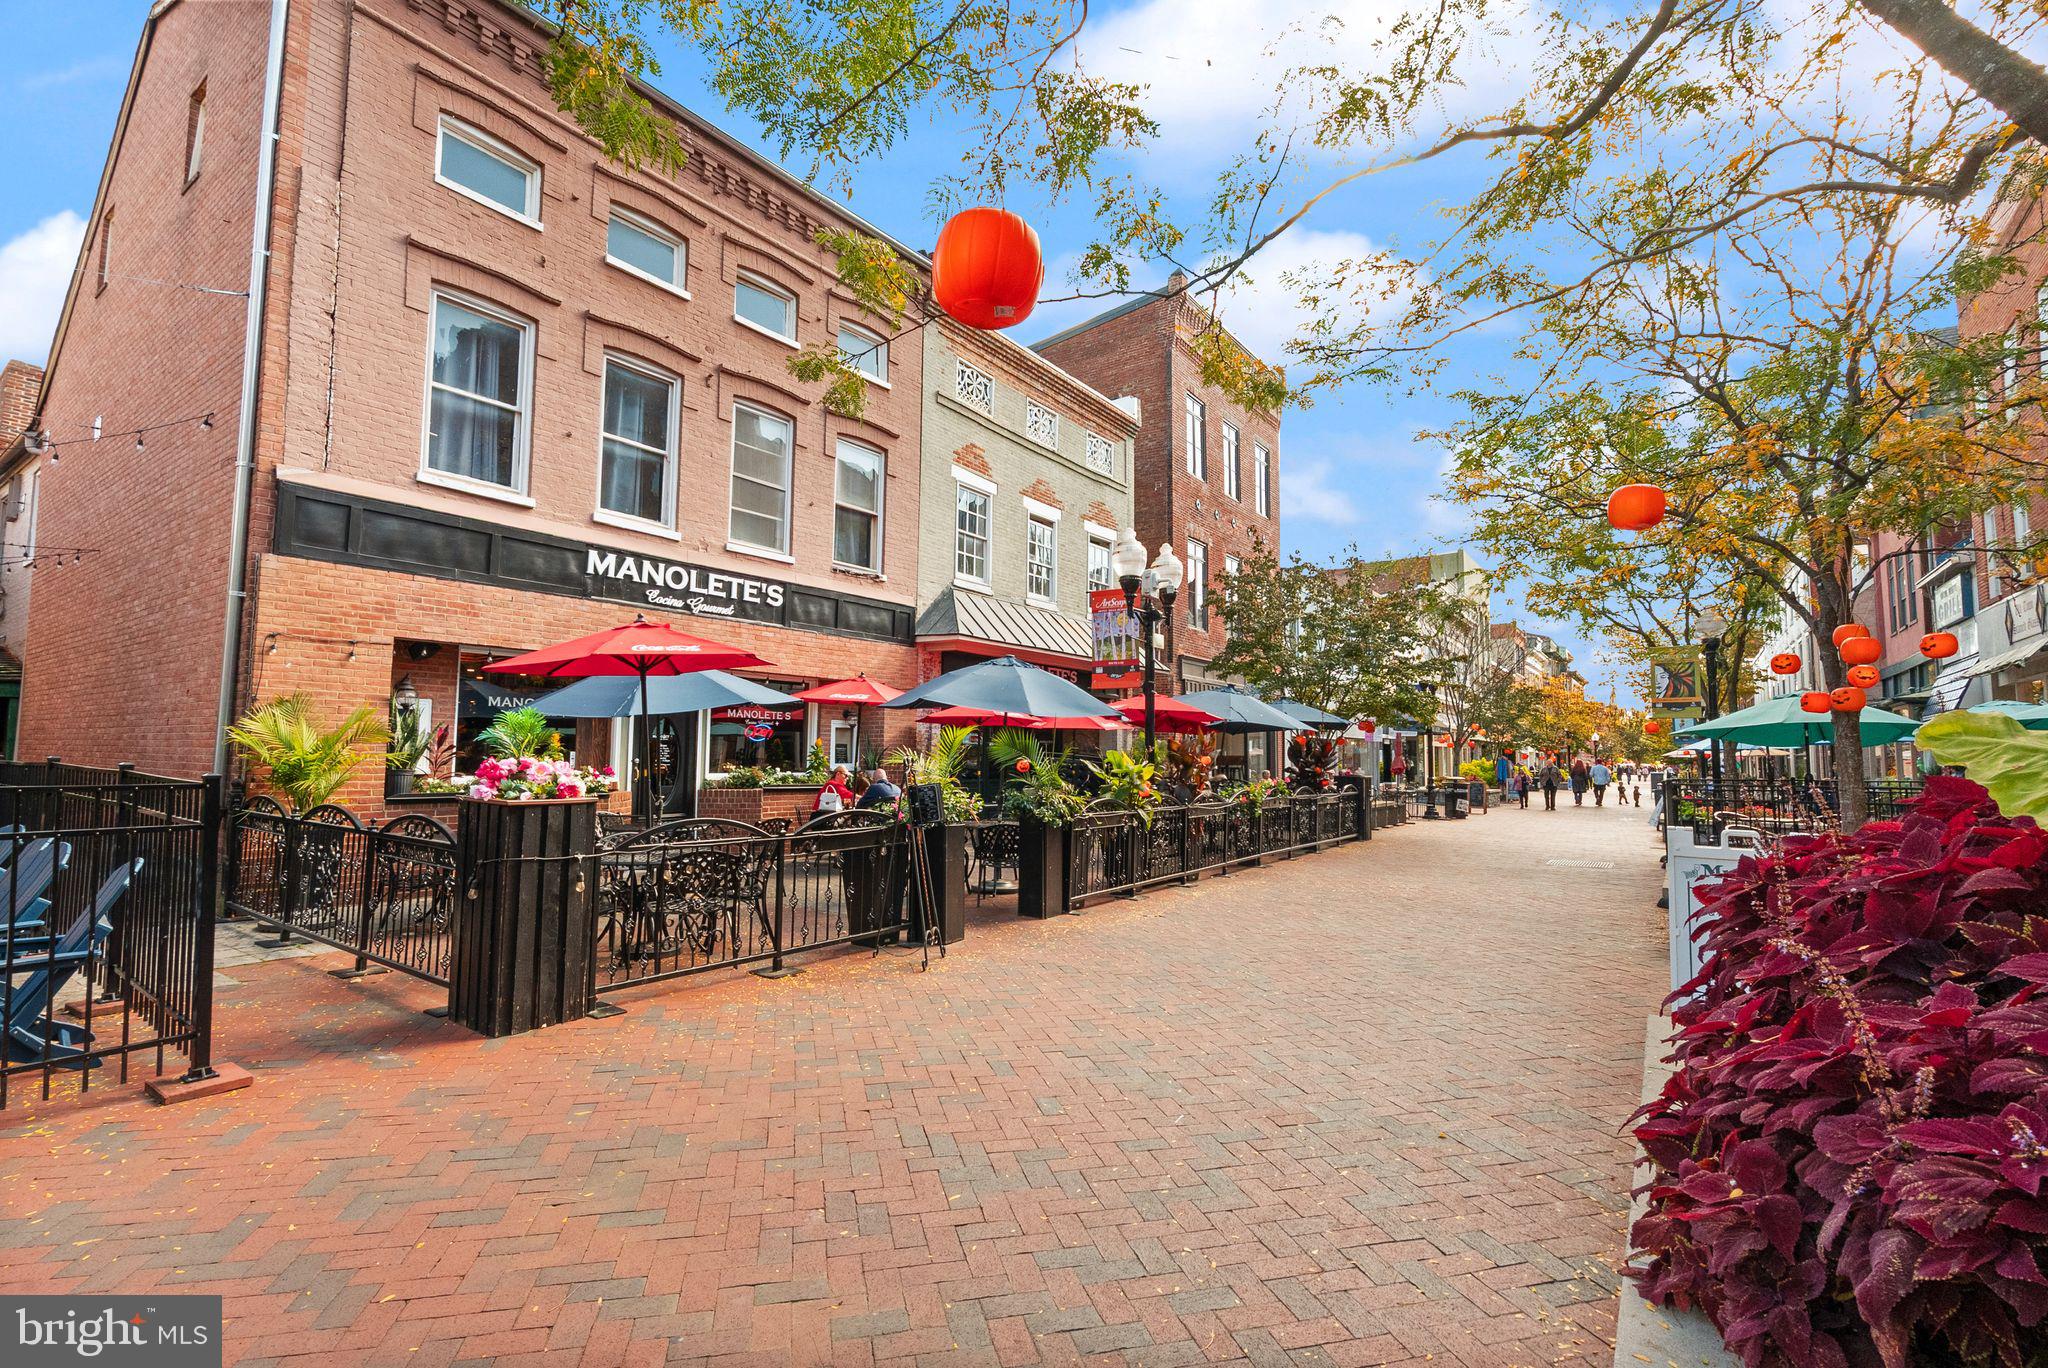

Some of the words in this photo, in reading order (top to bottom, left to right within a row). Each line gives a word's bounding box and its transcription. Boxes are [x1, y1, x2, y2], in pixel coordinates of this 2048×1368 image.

[586, 549, 784, 607] MANOLETE'S
[646, 589, 685, 608] Cocina
[686, 597, 735, 615] Gourmet
[1096, 597, 1126, 609] ArtScap
[1938, 594, 1961, 620] GRILL
